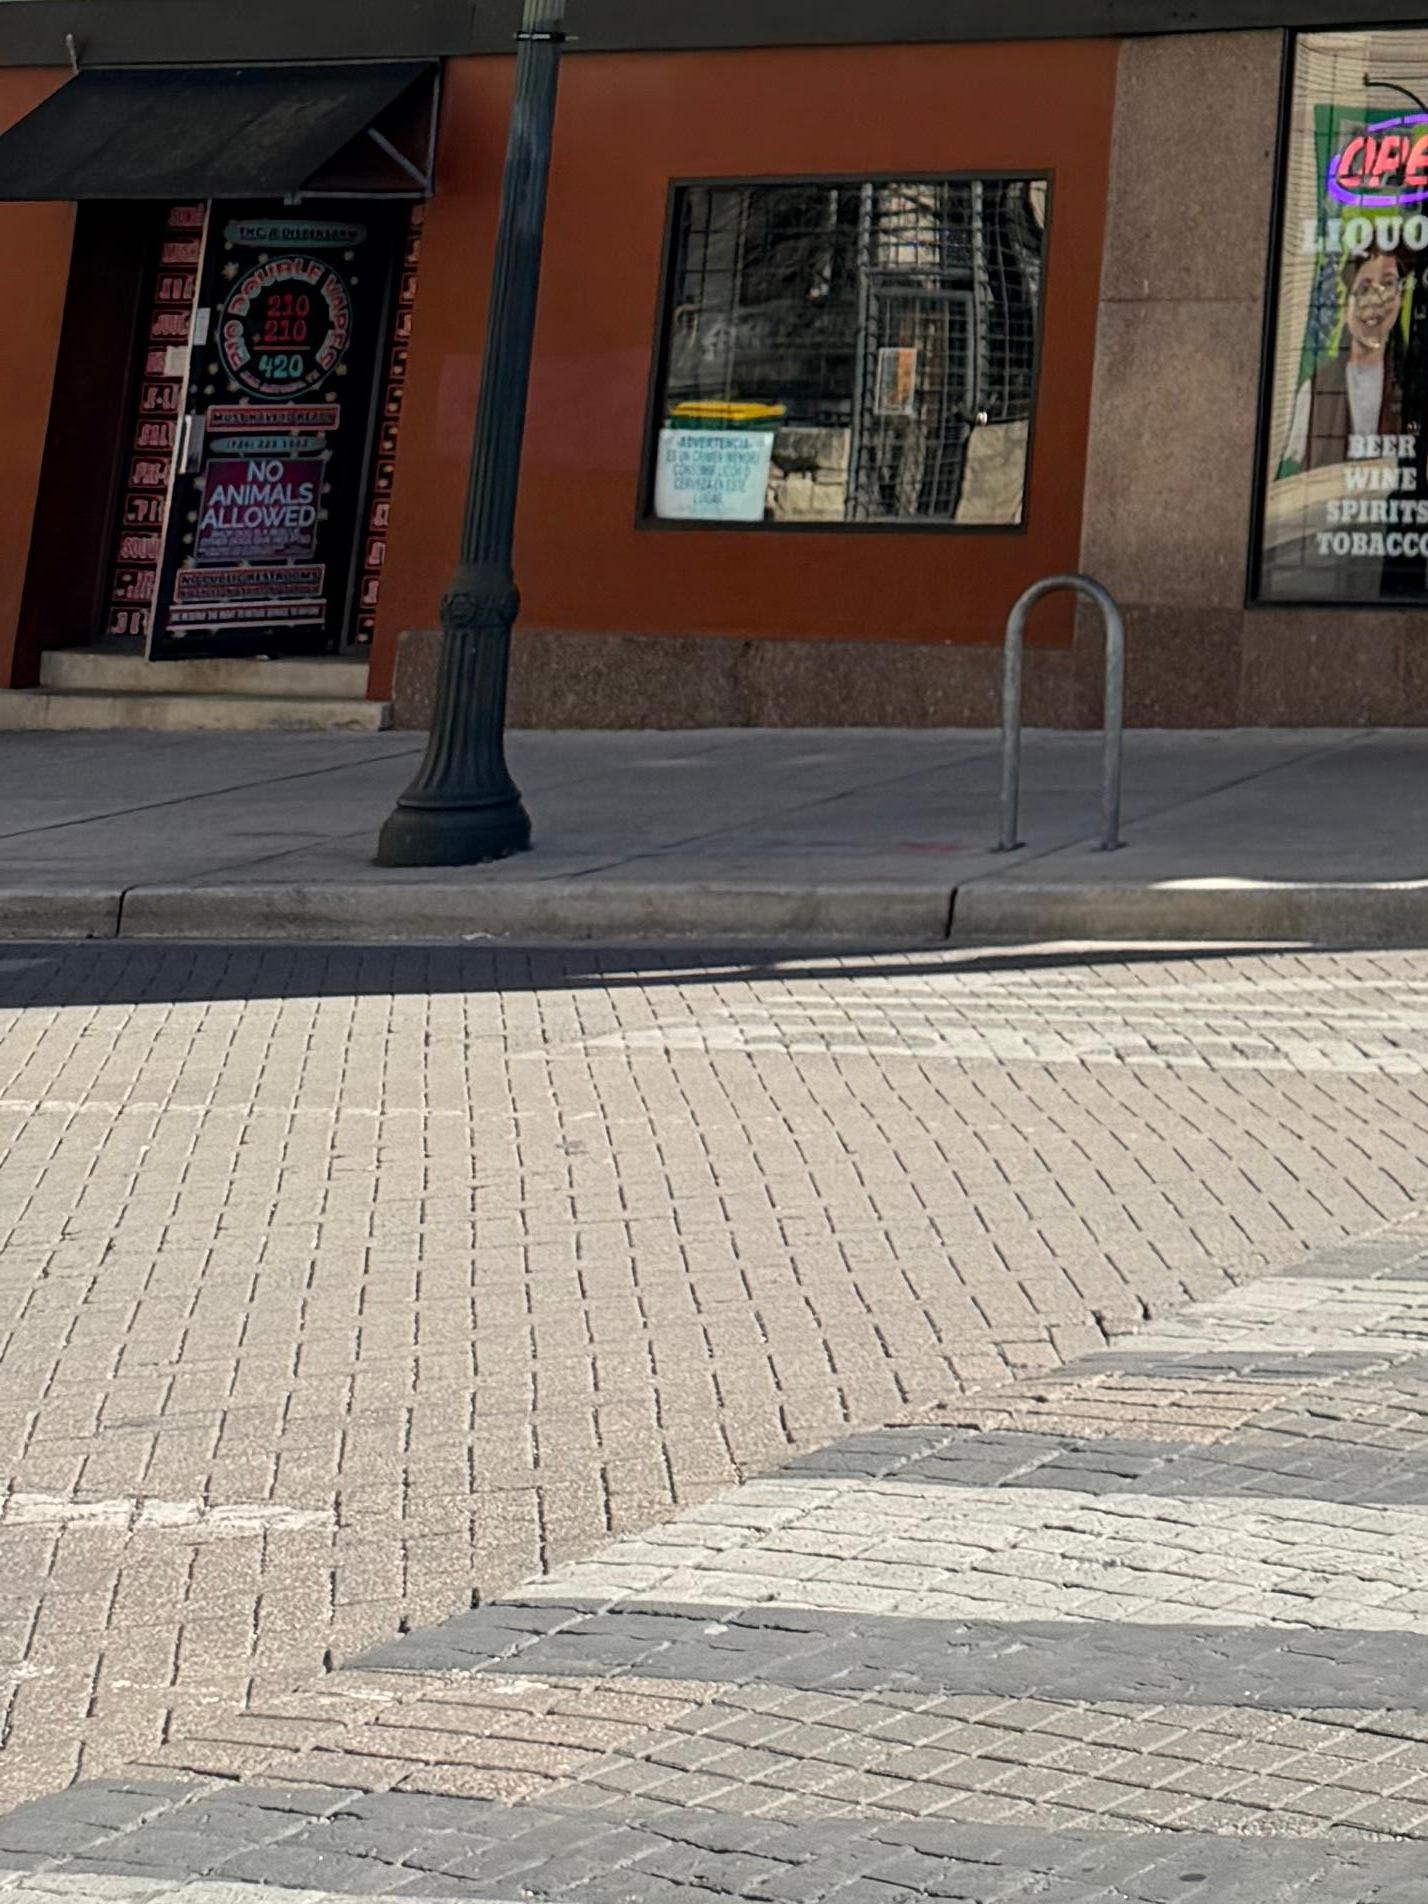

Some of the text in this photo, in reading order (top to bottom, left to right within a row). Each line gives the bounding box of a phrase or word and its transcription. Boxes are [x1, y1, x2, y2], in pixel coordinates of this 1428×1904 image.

[267, 294, 310, 318] 210
[263, 319, 308, 343] 210
[258, 355, 304, 379] 420
[1348, 434, 1416, 458] BEER
[247, 460, 284, 482] NO
[1345, 466, 1418, 491] WINE
[207, 482, 314, 506] ANIMALS
[200, 505, 316, 530] ALLOWED
